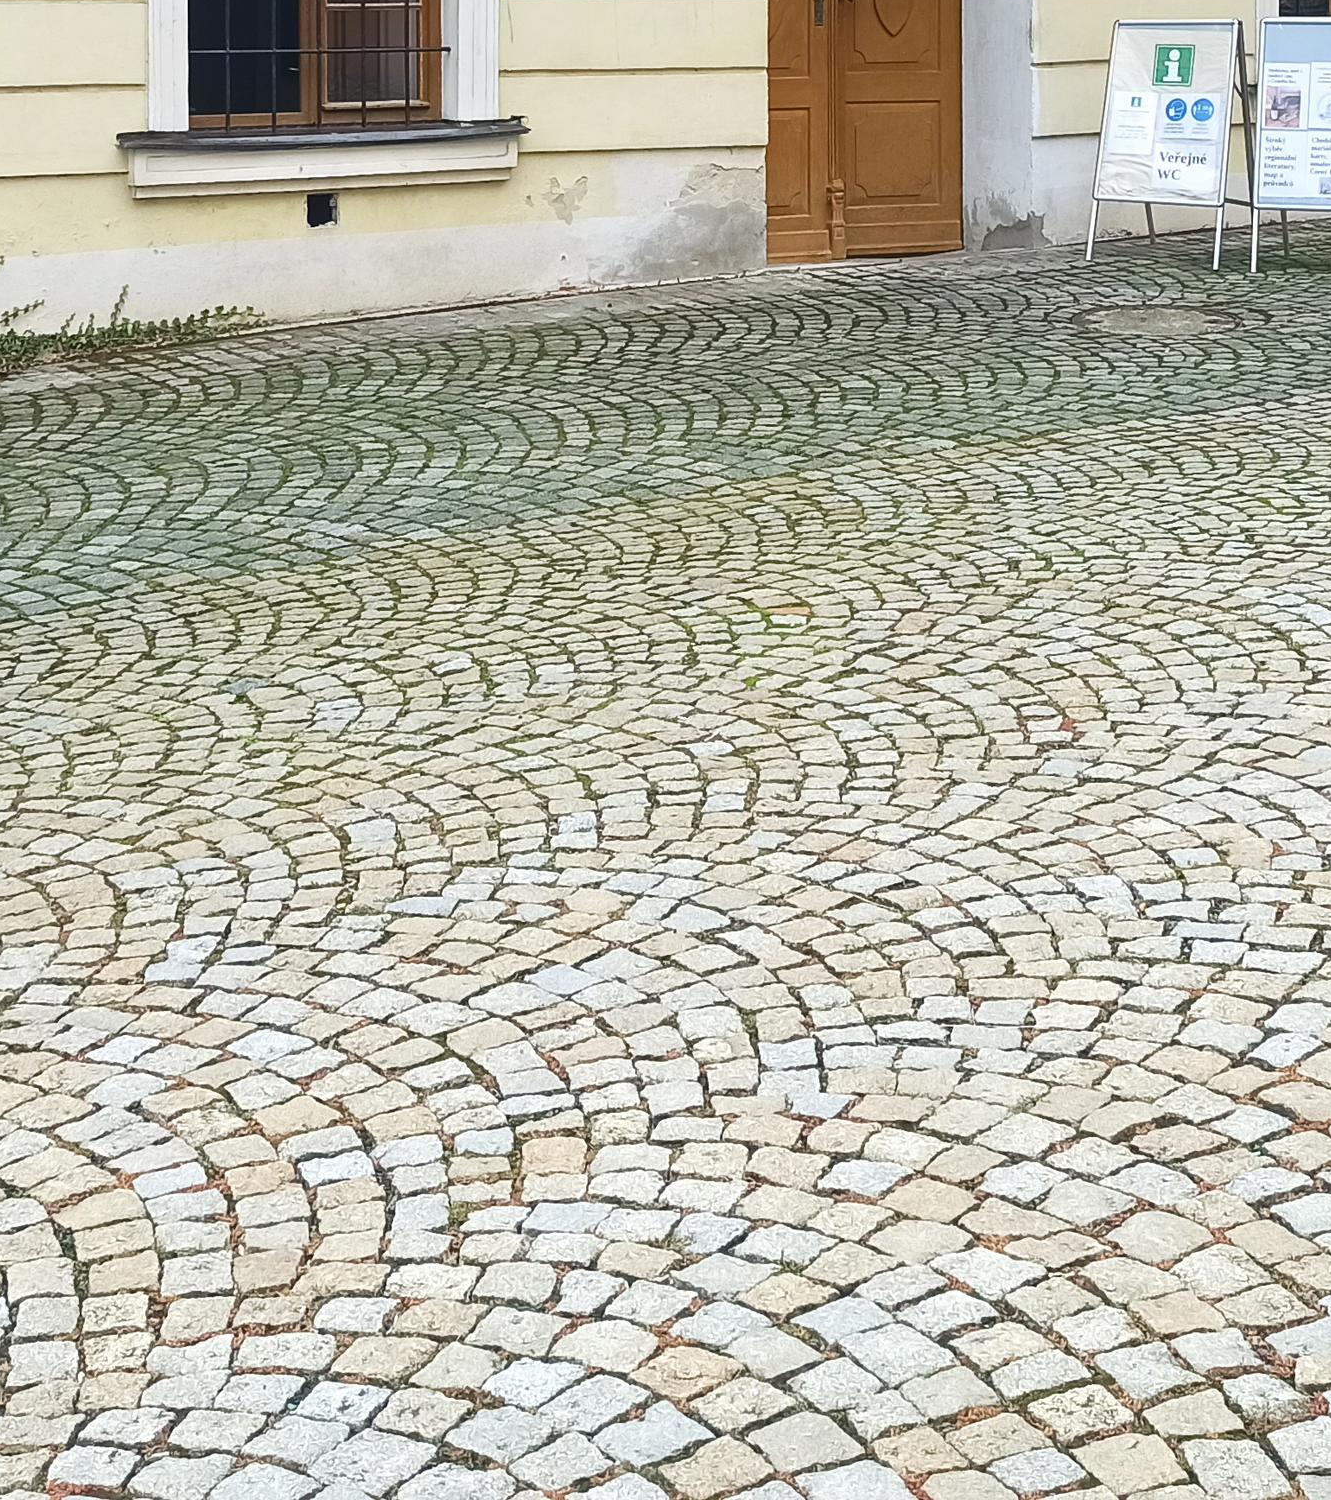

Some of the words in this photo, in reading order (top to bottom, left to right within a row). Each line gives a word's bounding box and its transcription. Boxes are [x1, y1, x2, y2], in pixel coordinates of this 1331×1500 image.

[1162, 48, 1182, 82] i
[1159, 151, 1207, 167] Veřejné
[1157, 169, 1182, 181] WC
